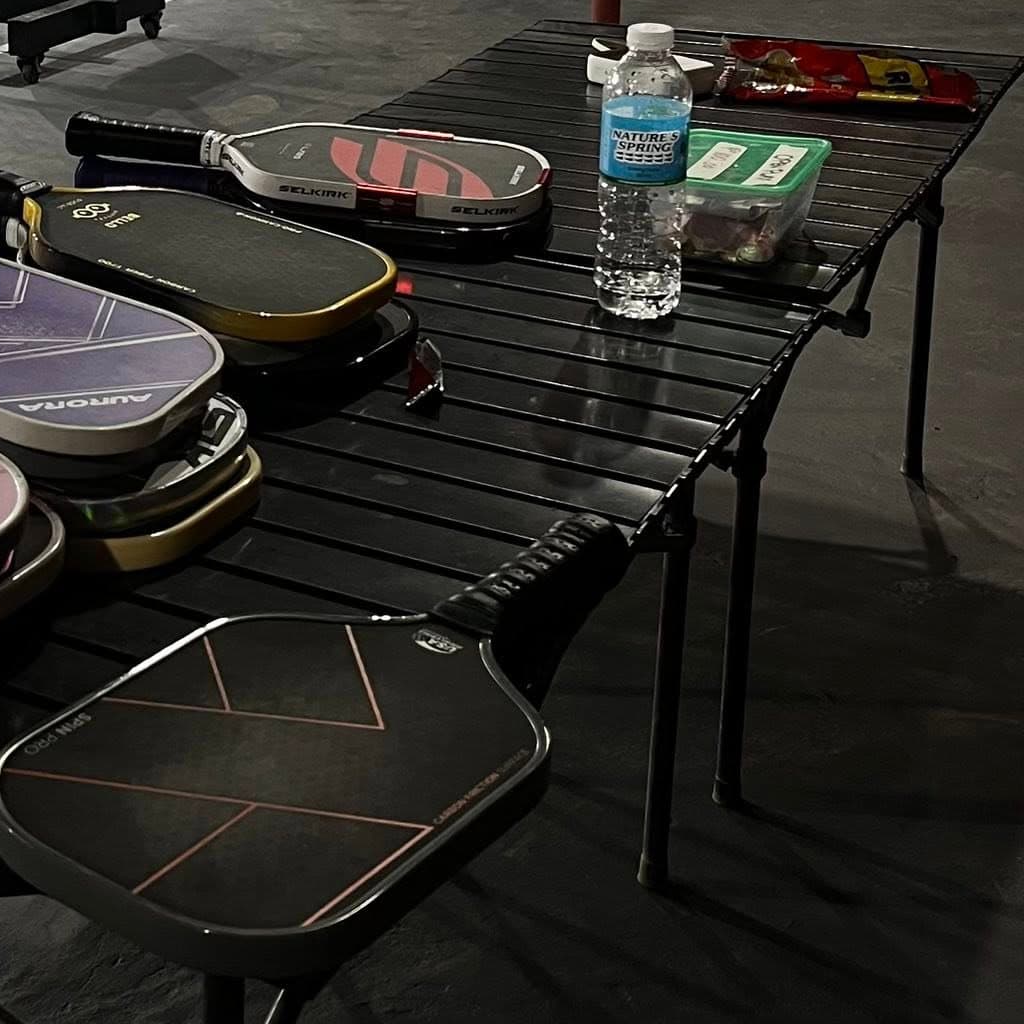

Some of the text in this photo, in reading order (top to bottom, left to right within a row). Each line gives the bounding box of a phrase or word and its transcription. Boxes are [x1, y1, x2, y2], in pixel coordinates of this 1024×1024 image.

[617, 140, 673, 153] SPRING
[279, 185, 352, 199] SELKIRK
[450, 205, 521, 216] SELKIRK
[18, 391, 154, 413] AURORA
[23, 712, 92, 756] SPIN PRO
